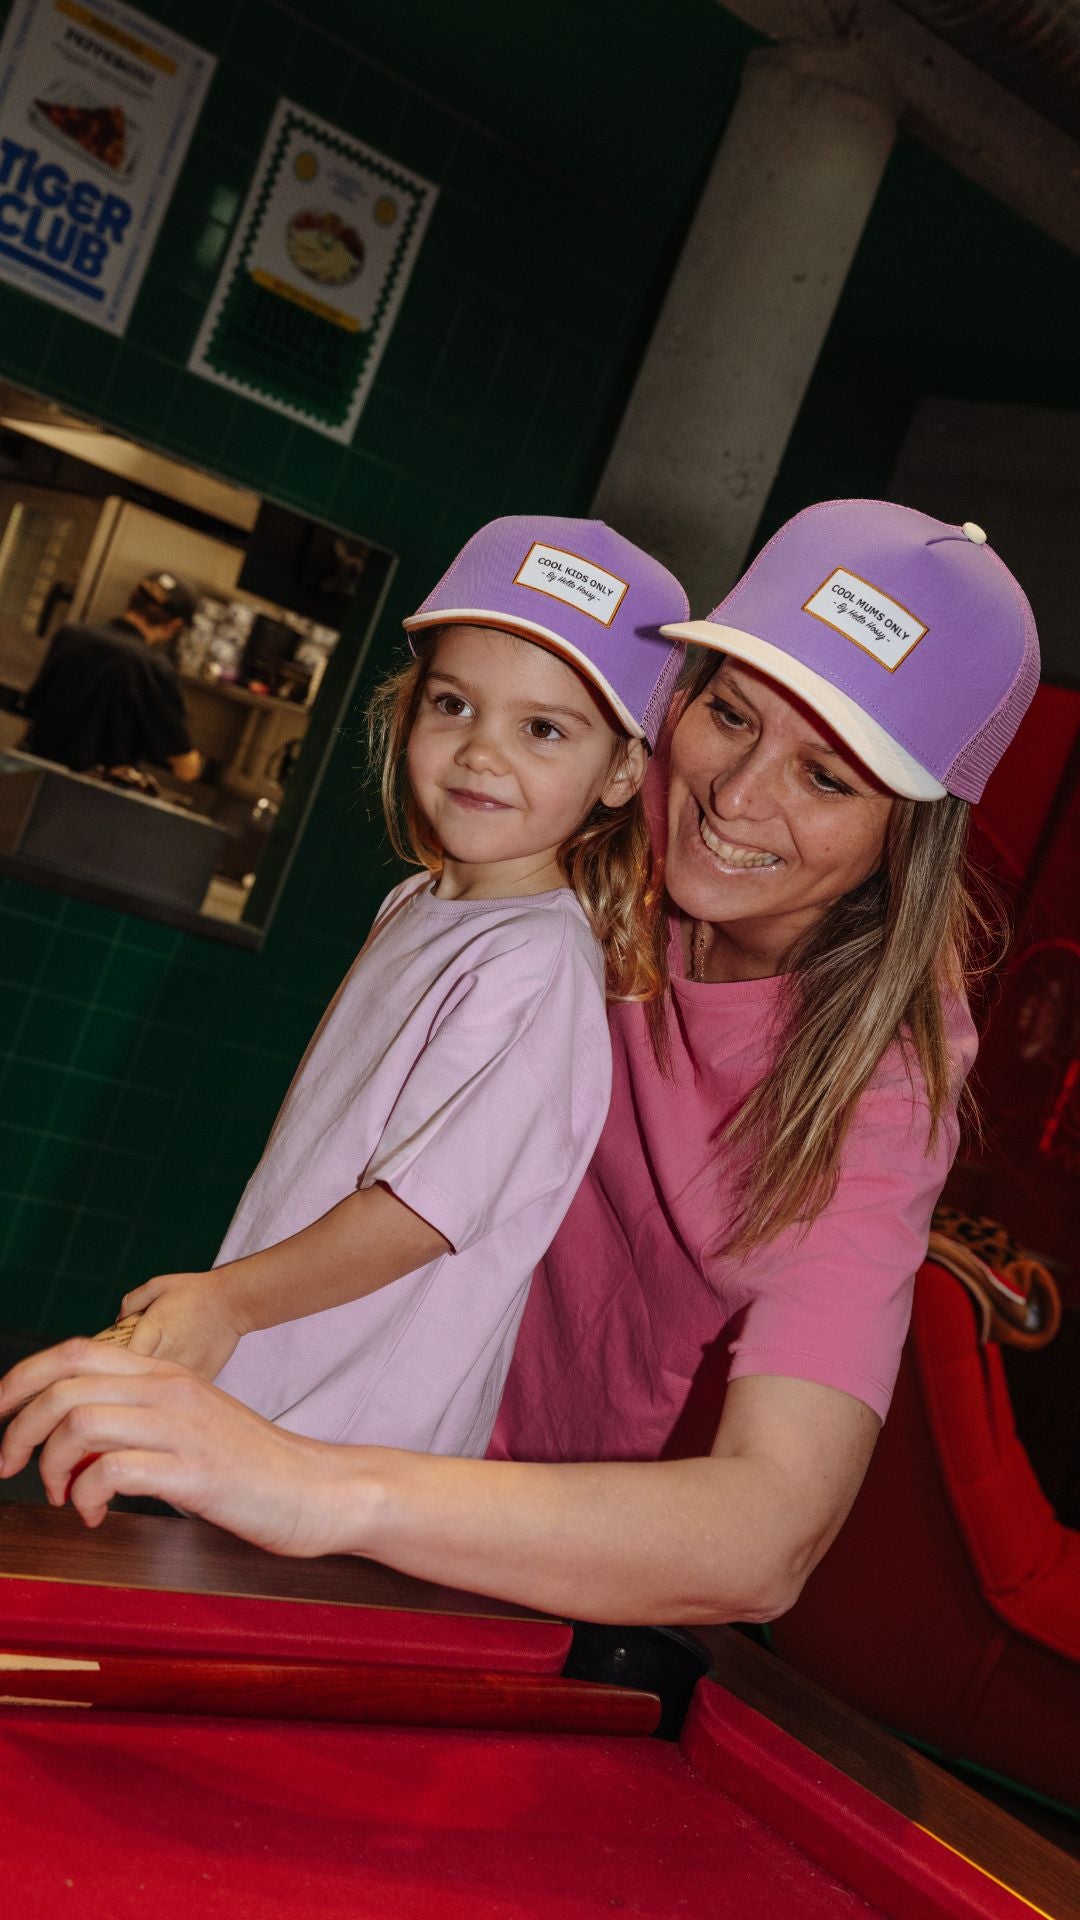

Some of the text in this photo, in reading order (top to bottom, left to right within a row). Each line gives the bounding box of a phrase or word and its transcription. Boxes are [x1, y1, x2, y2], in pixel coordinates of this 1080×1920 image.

[0, 138, 133, 244] TIGER
[0, 193, 108, 279] CLUB
[538, 557, 614, 596] COOL KIDS ONLY
[546, 571, 556, 583] By
[557, 576, 576, 589] Hello
[831, 584, 910, 641] COOL MUMS ONLY
[837, 602, 848, 614] By
[848, 609, 865, 624] Hello
[866, 622, 885, 640] Hossy
